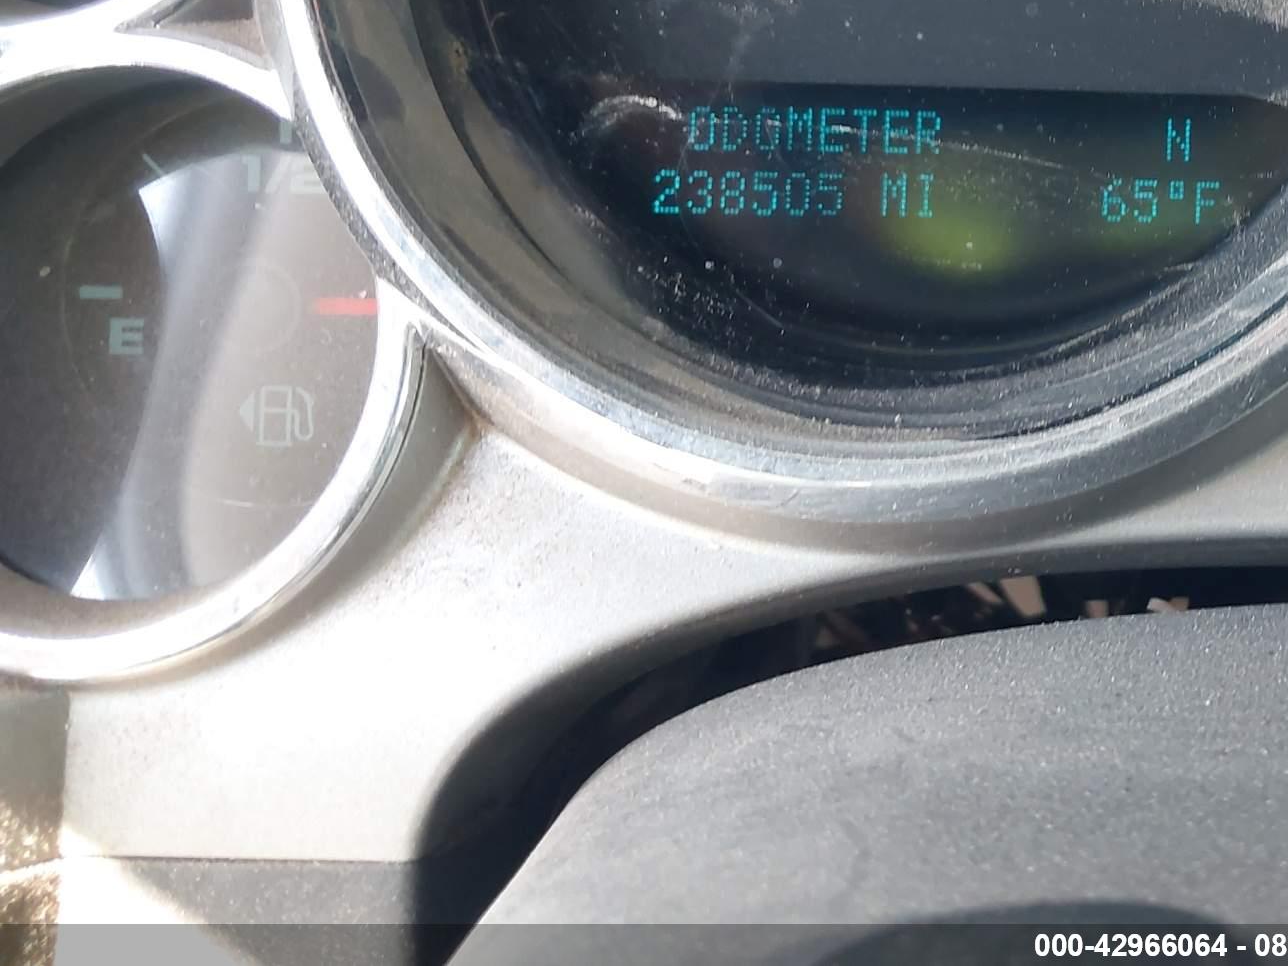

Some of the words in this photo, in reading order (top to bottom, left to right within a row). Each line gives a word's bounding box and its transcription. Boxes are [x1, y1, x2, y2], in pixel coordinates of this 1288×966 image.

[688, 106, 942, 155] ODOMETER
[1166, 117, 1192, 162] N
[651, 169, 844, 216] 238505
[881, 172, 934, 218] MI
[1101, 179, 1220, 225] 65°F
[109, 318, 144, 355] E
